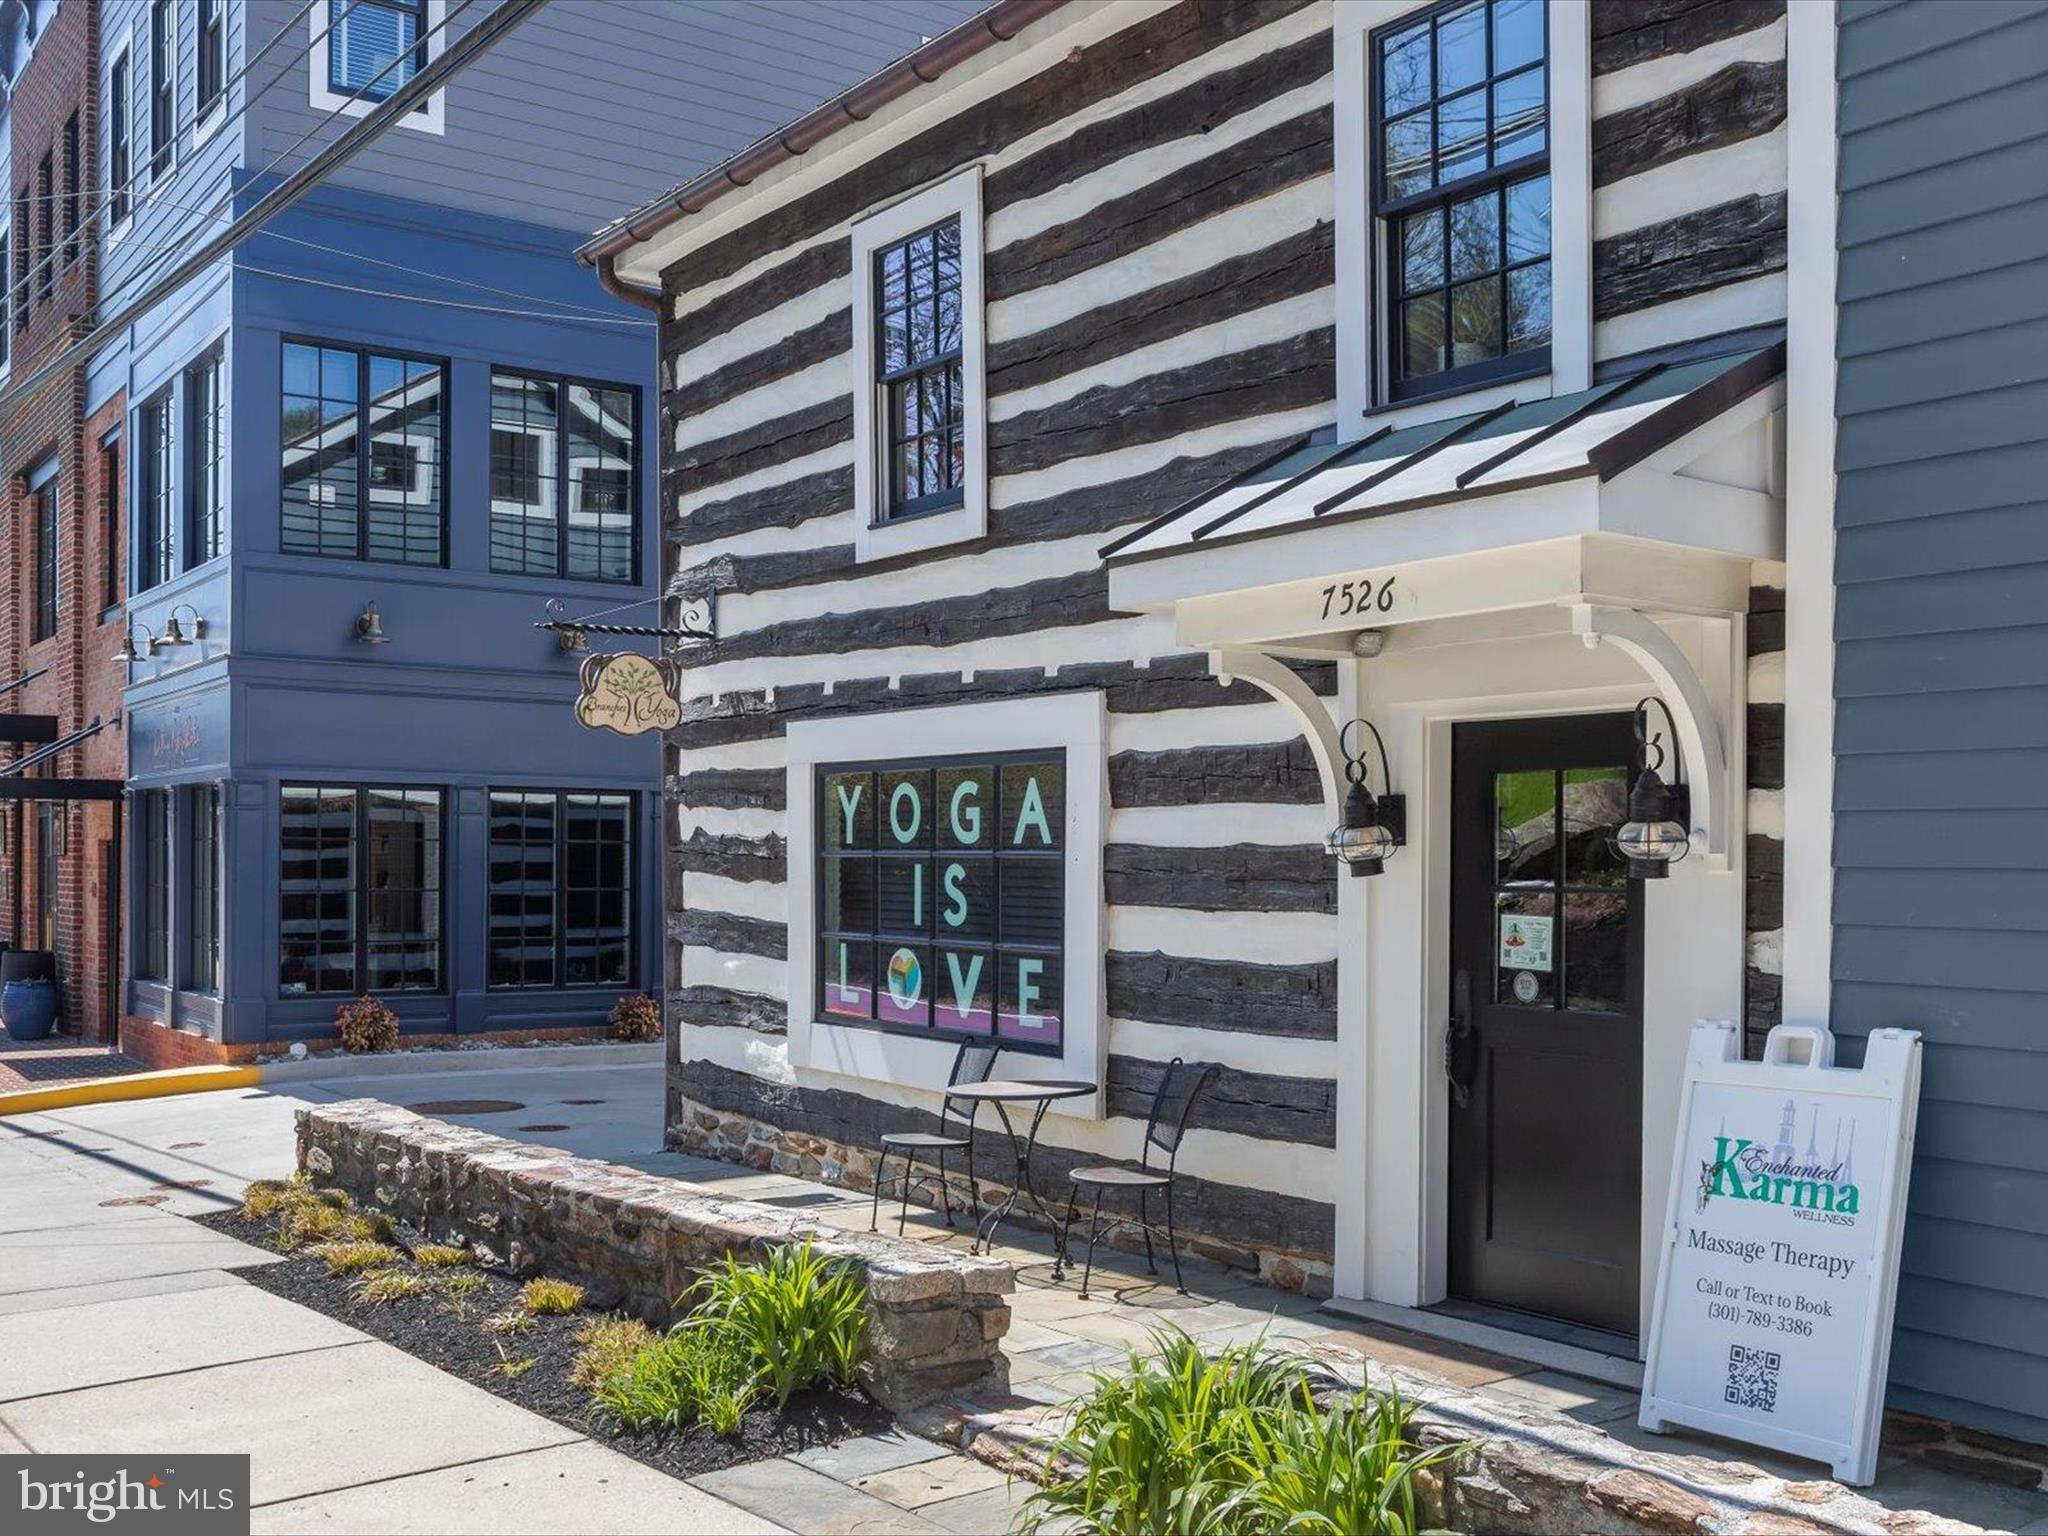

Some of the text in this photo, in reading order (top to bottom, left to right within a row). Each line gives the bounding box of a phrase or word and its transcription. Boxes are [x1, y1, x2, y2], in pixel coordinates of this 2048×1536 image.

[1322, 576, 1396, 620] 7526
[639, 690, 676, 725] Yoga
[836, 776, 1053, 844] YOGA
[913, 863, 968, 927] IS
[840, 943, 1044, 1028] LOVE
[1708, 1136, 1861, 1214] Karma
[1740, 1147, 1844, 1182] Enchanted
[1793, 1208, 1856, 1227] WELLNESS
[1687, 1228, 1856, 1280] Massage Therapy
[1696, 1276, 1832, 1317] Call or Text to Book
[1708, 1301, 1813, 1337] (301)-789-3386
